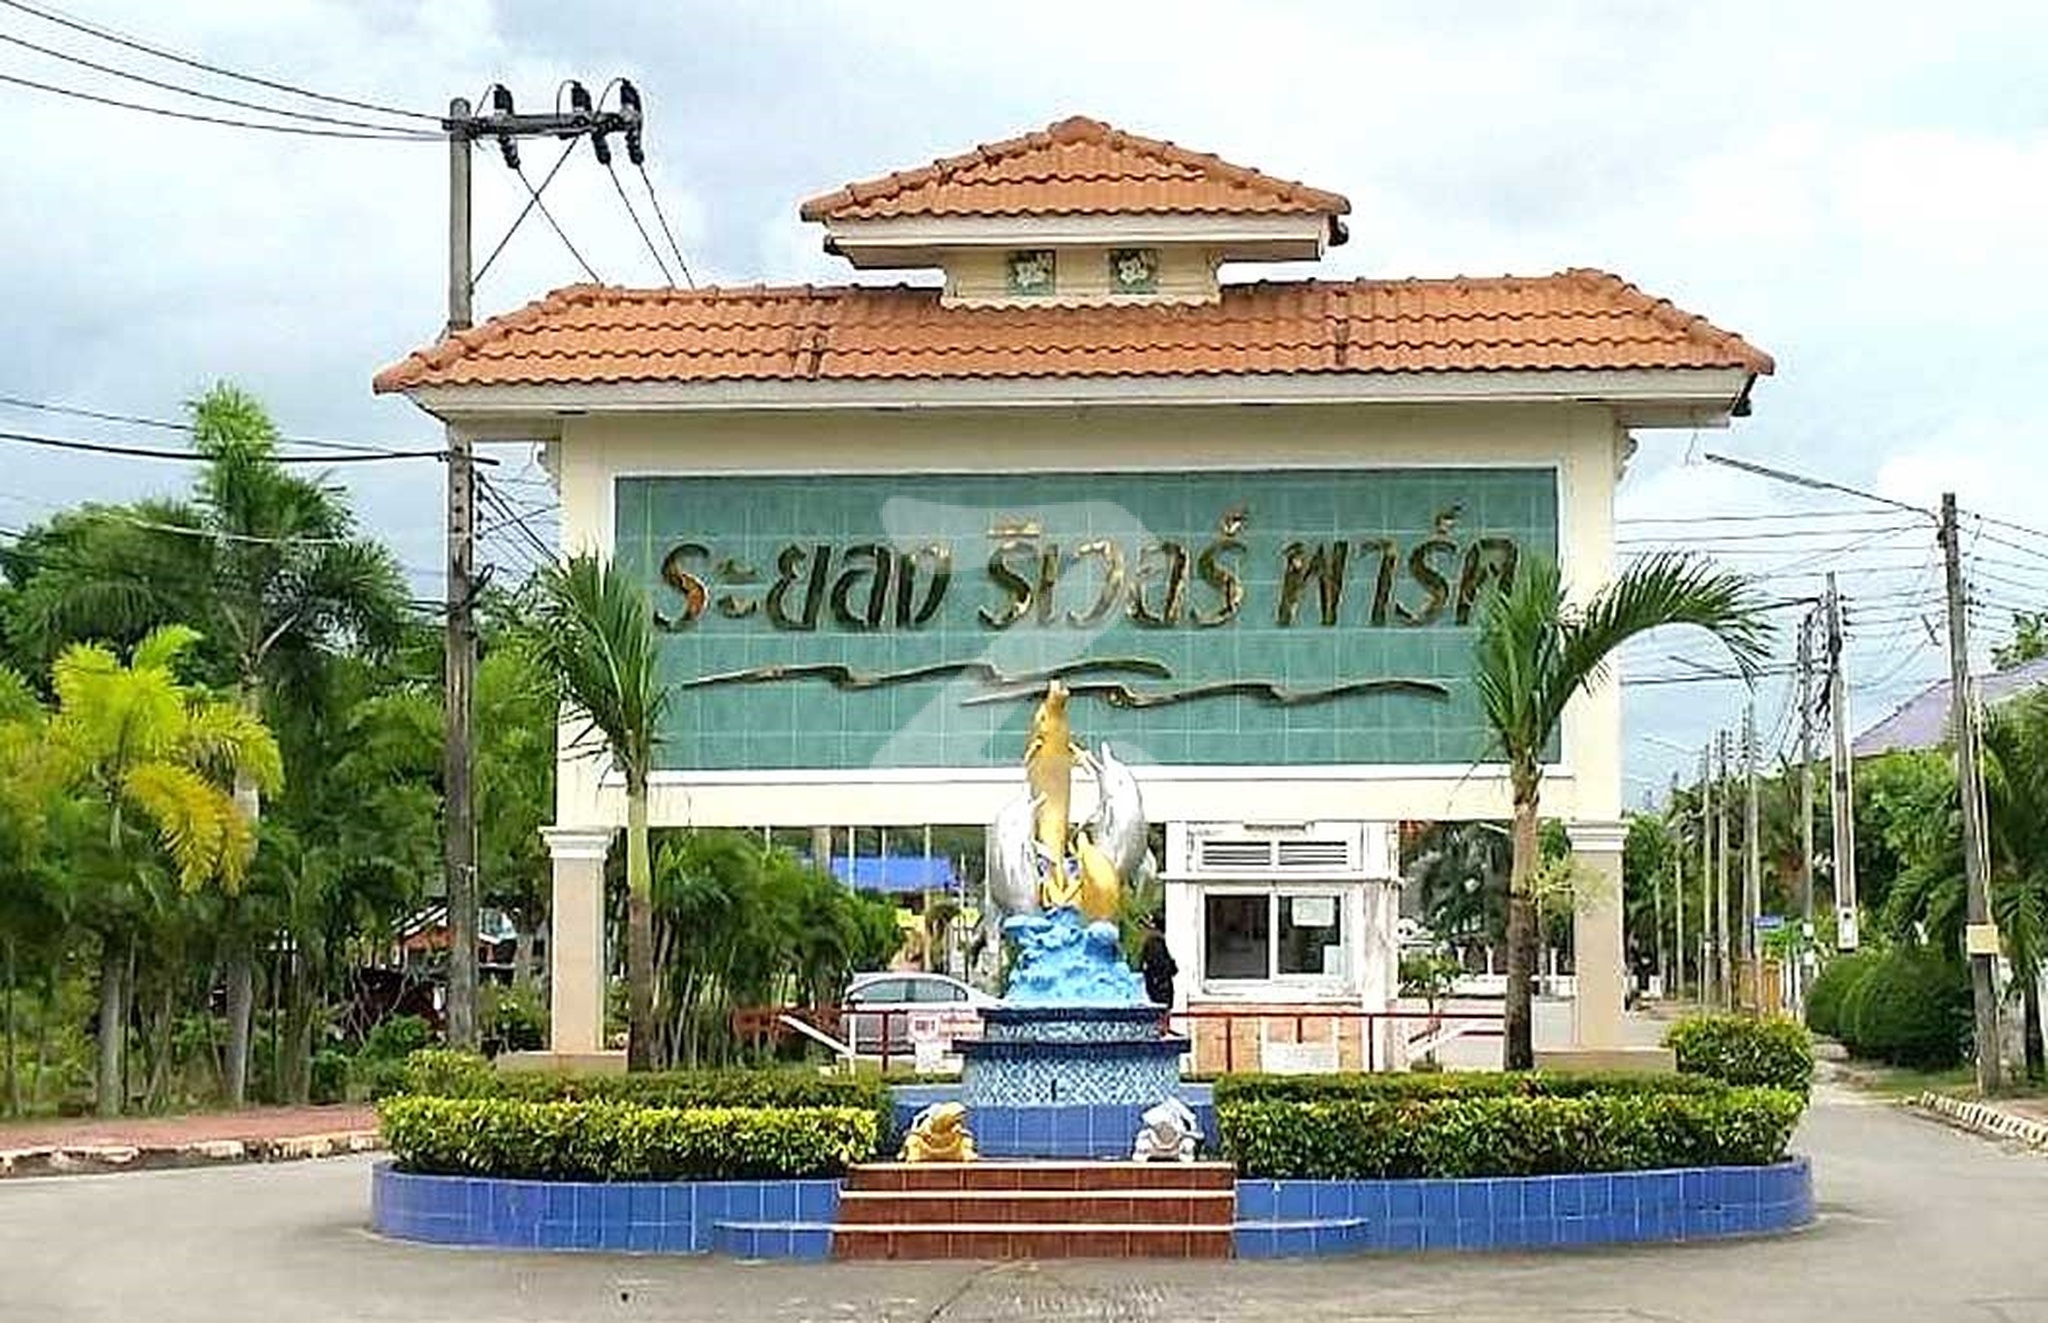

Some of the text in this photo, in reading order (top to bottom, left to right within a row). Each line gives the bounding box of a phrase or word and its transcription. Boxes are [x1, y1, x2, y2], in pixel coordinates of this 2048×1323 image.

[653, 540, 952, 632] ระยอง
[977, 502, 1250, 629] ริเวอร์
